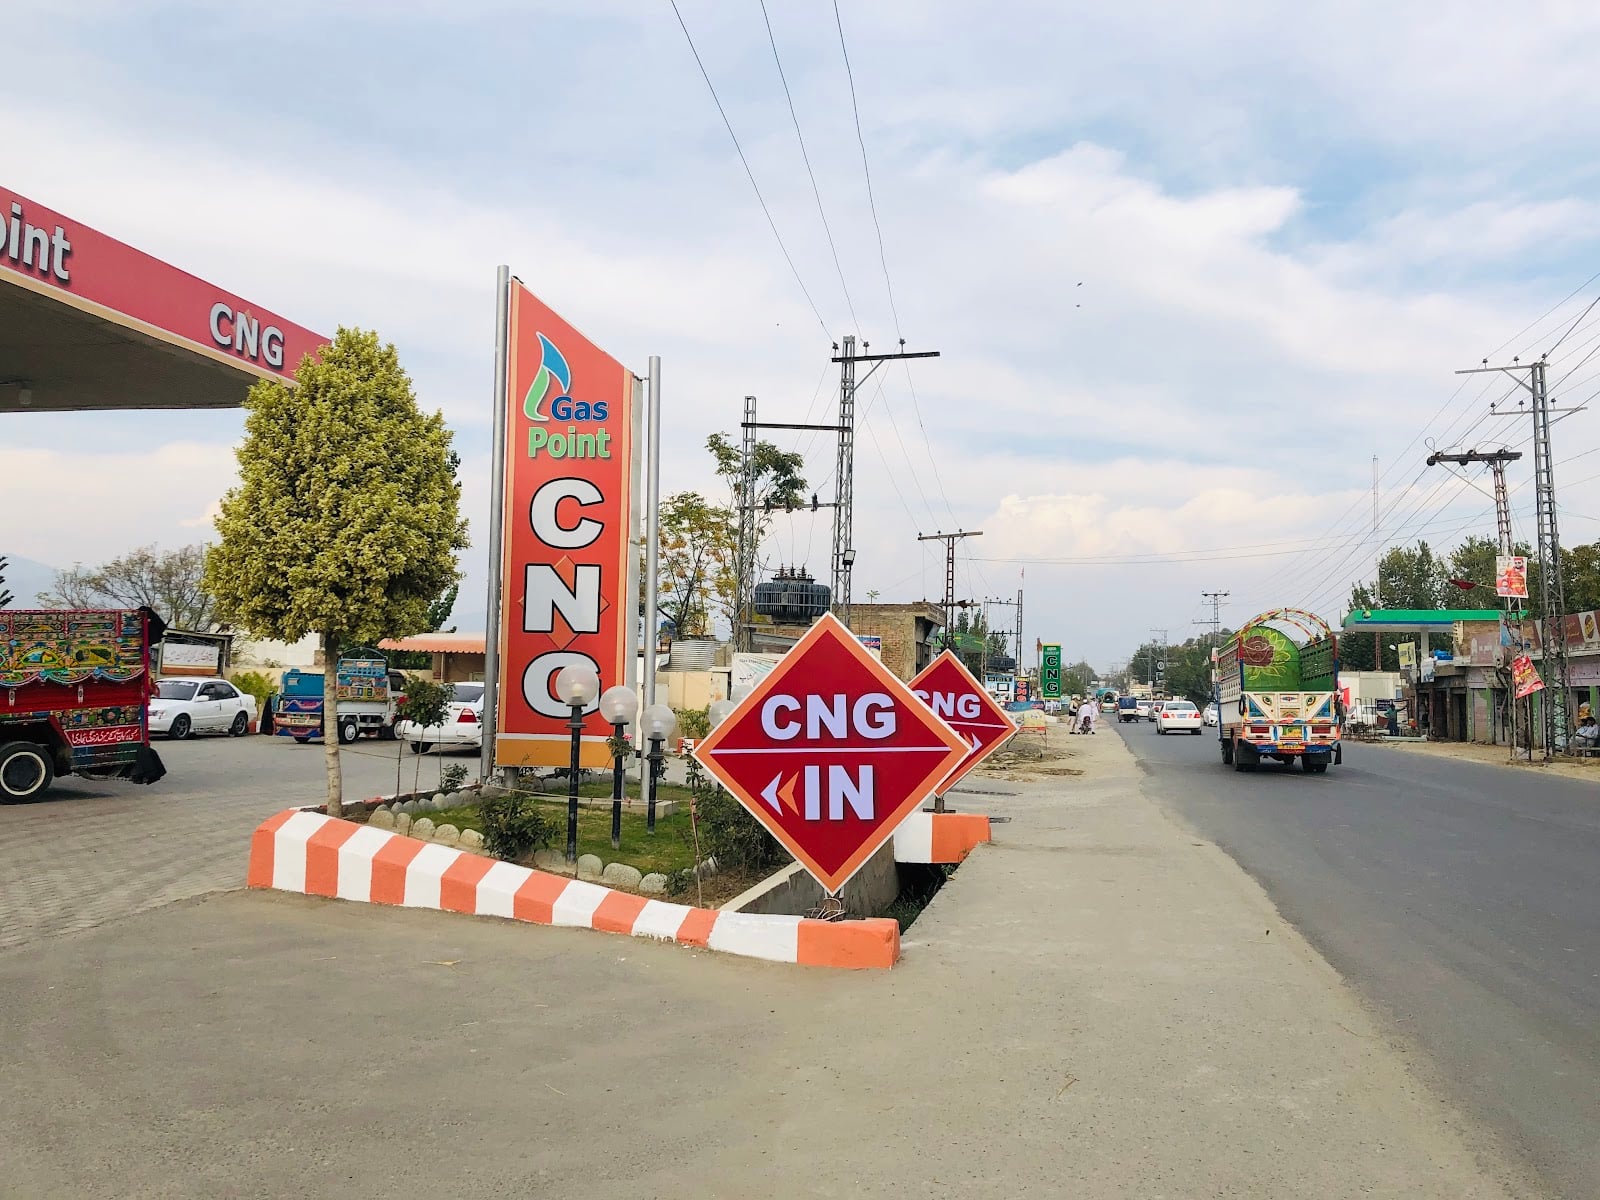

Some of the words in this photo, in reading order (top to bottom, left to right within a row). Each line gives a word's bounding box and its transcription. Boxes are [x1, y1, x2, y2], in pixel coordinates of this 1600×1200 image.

[210, 302, 284, 367] CNG
[551, 397, 609, 421] Gas
[528, 427, 611, 459] Point
[522, 477, 604, 719] CNG
[1046, 656, 1059, 692] CNG
[761, 692, 896, 740] CNG
[804, 765, 875, 821] IN
